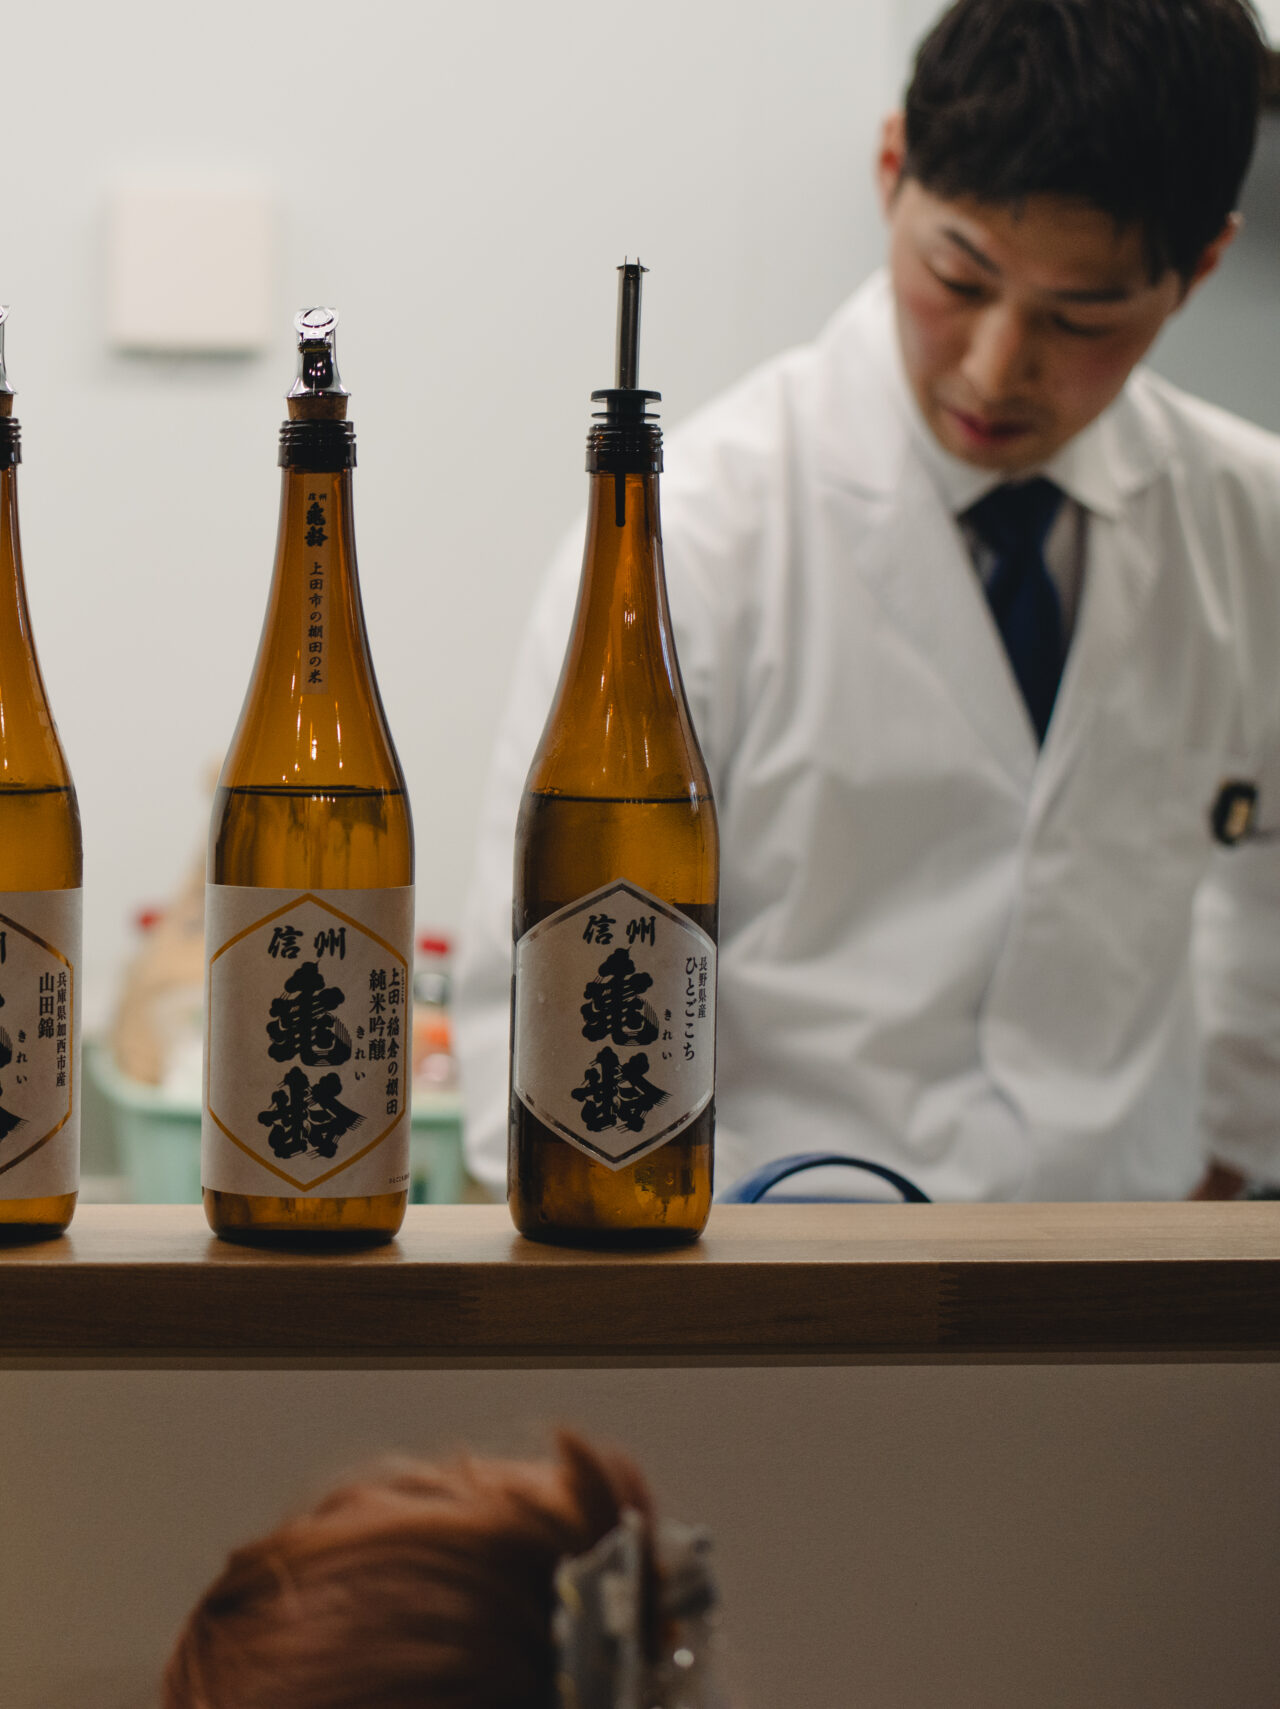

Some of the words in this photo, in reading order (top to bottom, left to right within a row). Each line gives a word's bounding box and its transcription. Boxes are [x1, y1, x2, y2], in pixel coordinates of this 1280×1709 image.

[307, 561, 324, 684] 上田市の棚田の米
[267, 925, 347, 961] 信州
[582, 913, 657, 947] 信州
[37, 972, 55, 1039] 山田錦
[368, 968, 387, 1061] 純米吟醸
[682, 956, 698, 1061] ひとごこち
[697, 956, 708, 1019] 長野県産
[15, 1029, 28, 1085] きれい
[56, 971, 67, 1088] 兵庫県加西市産
[354, 1025, 366, 1081] きれい
[661, 1008, 673, 1060] きれい
